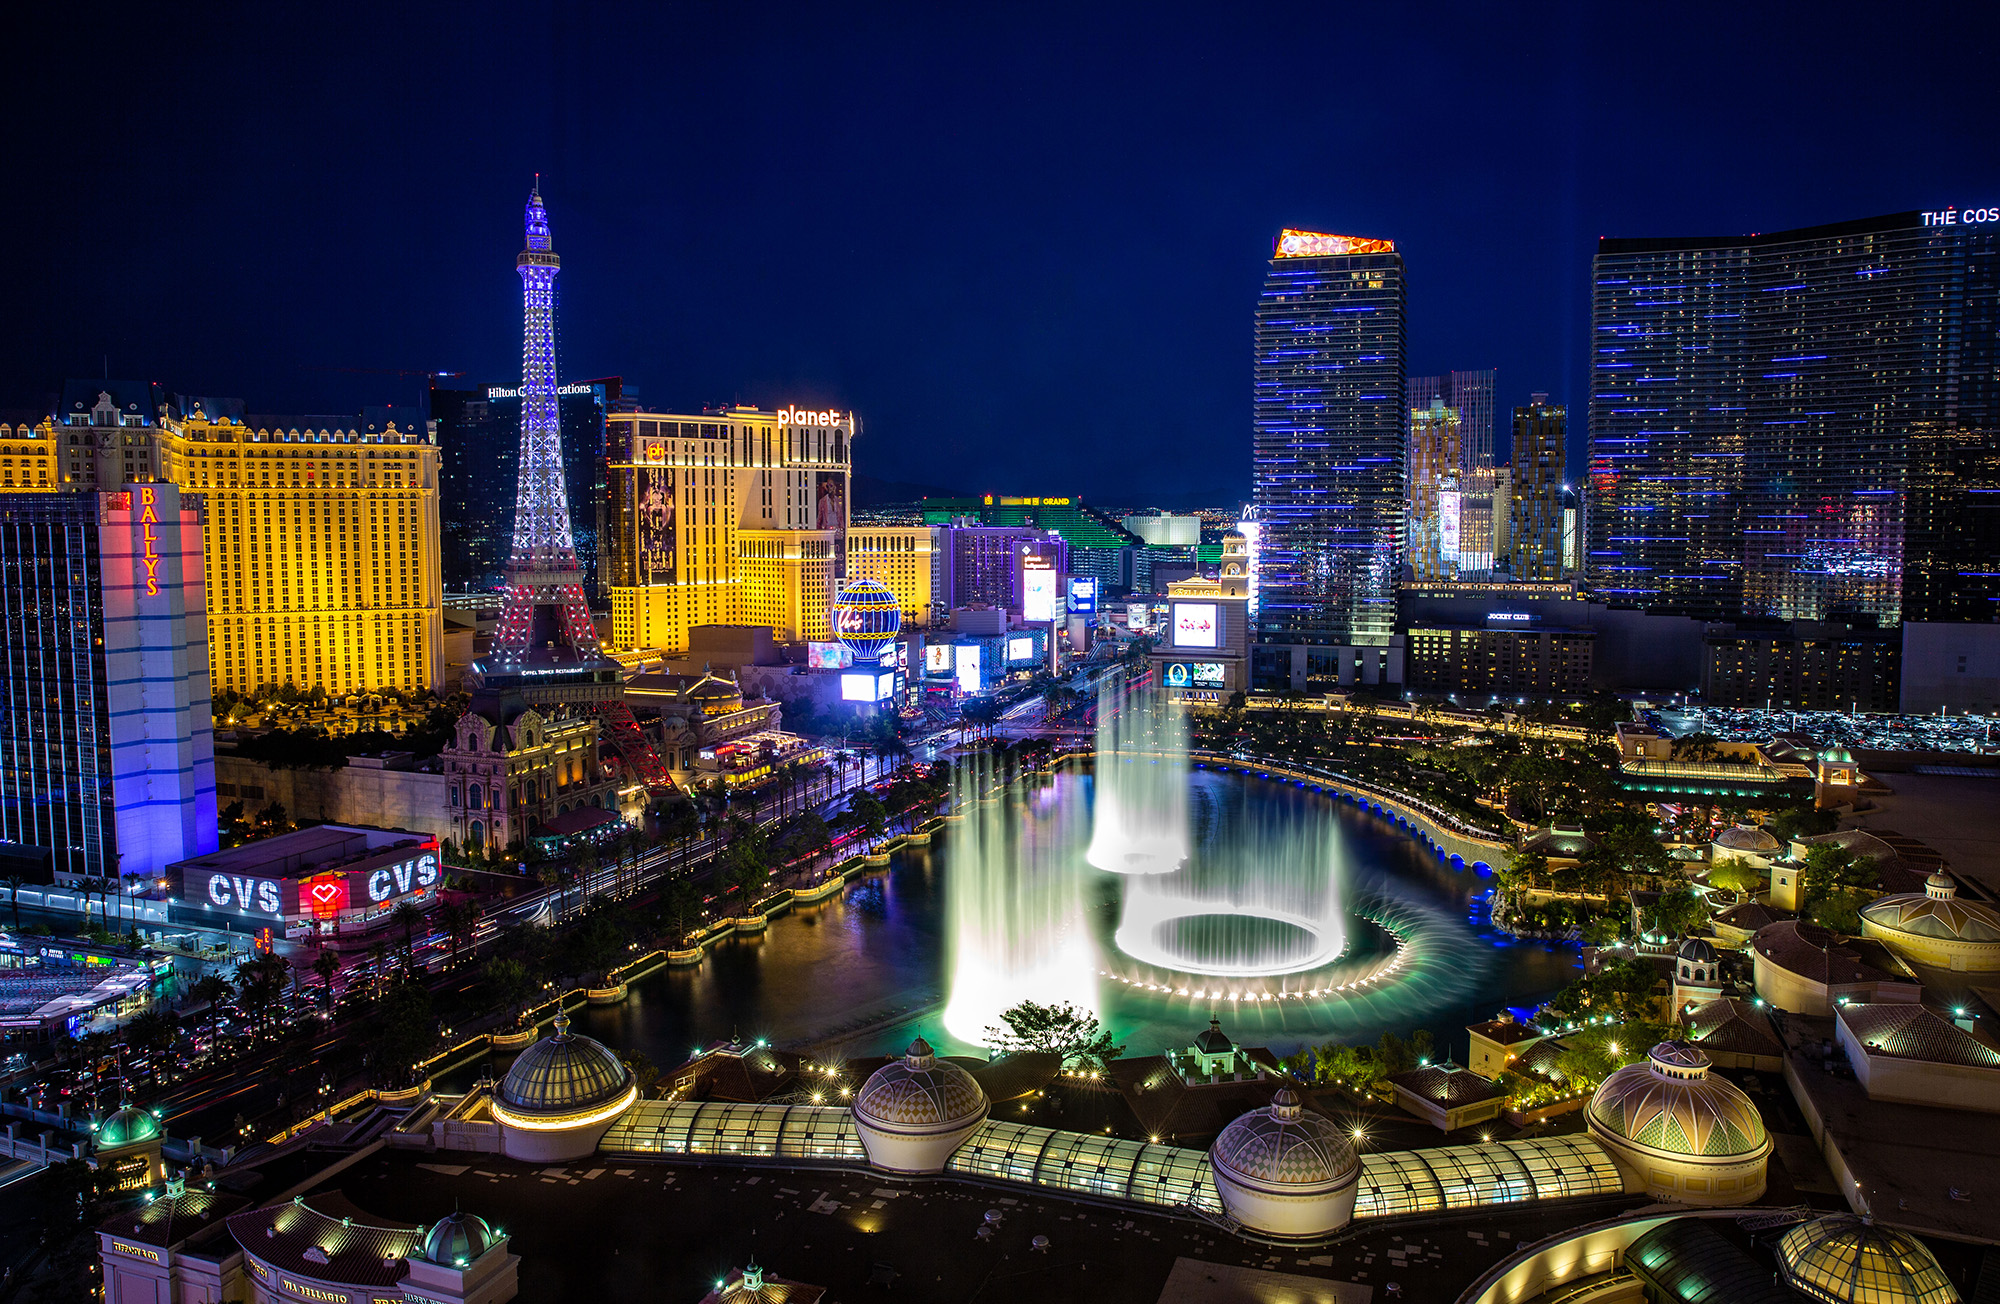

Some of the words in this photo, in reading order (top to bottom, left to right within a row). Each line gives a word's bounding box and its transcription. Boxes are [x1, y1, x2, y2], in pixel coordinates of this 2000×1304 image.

[1921, 211, 1957, 226] THE
[1963, 208, 2000, 223] COS
[488, 388, 516, 398] Hilton
[557, 384, 591, 395] cations
[777, 404, 840, 429] planet
[649, 443, 664, 456] ph
[140, 487, 160, 596] BALLYS
[1174, 587, 1220, 597] BELLAGIO
[838, 606, 863, 636] Paris
[368, 854, 437, 901] CVS
[208, 874, 280, 913] CVS
[86, 956, 113, 965] SUBWAY
[283, 1280, 297, 1292] VIA
[299, 1286, 347, 1304] BELLAGIO
